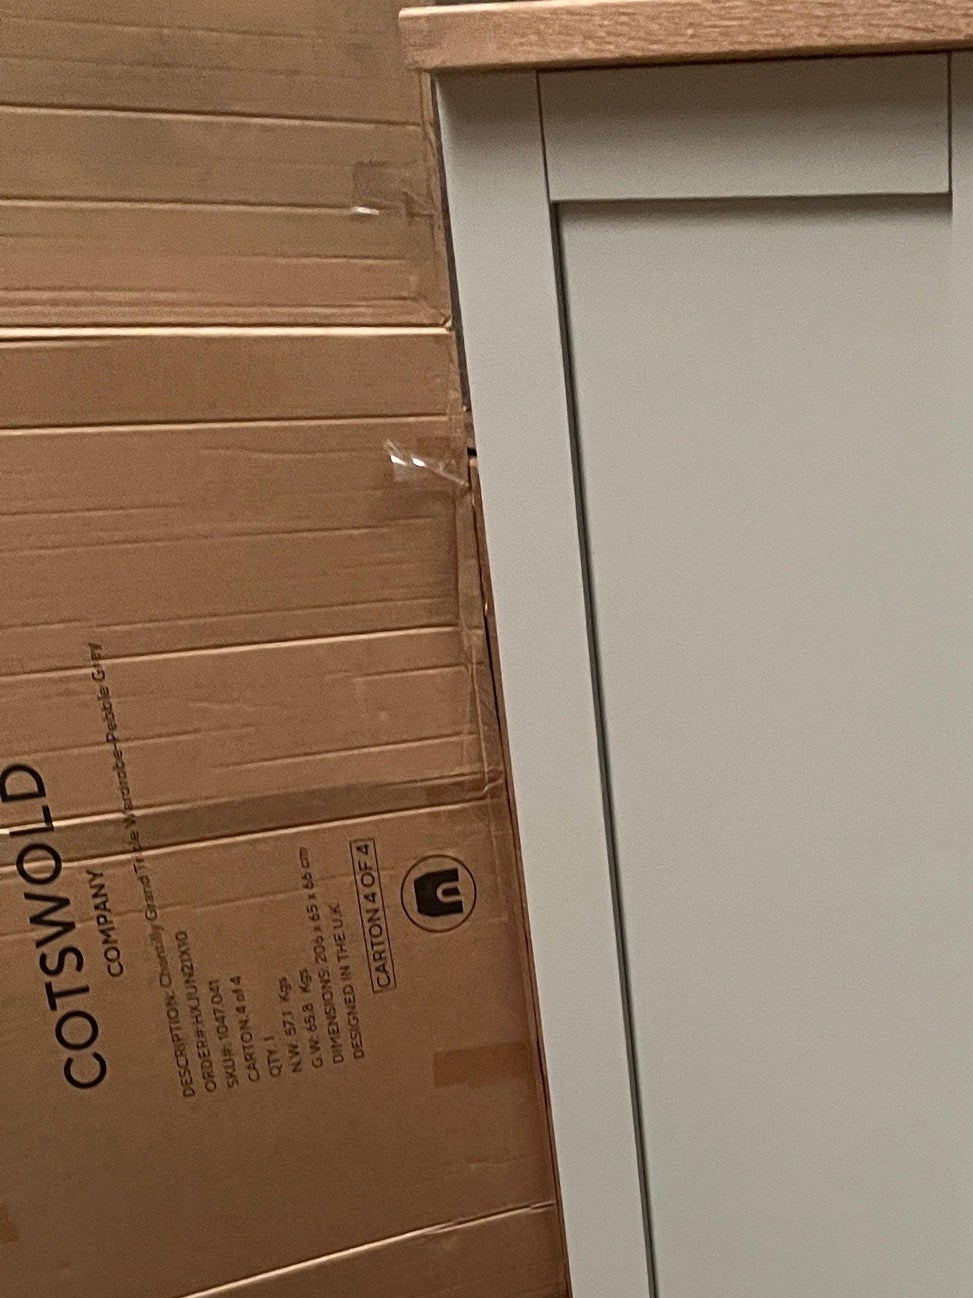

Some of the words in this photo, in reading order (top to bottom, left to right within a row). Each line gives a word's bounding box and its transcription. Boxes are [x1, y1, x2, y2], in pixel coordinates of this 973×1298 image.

[130, 830, 145, 873] Trple
[300, 846, 310, 868] cm
[356, 844, 368, 856] 4
[302, 871, 314, 890] 66
[358, 860, 375, 888] OF
[138, 875, 158, 922] Grand
[363, 892, 377, 903] 4
[85, 870, 124, 977] COMPANY
[306, 902, 320, 922] 65
[0, 764, 107, 1089] COTSWOLD
[313, 935, 327, 964] 206
[334, 931, 348, 962] THE
[366, 908, 391, 988] CARTON
[230, 976, 241, 984] 4
[298, 968, 312, 993] Kgs
[339, 965, 351, 981] IN
[232, 989, 245, 1002] of
[278, 976, 292, 1002] Kgs
[209, 980, 228, 1040] 1047.041
[235, 1005, 246, 1014] 4
[318, 967, 344, 1064] DIMENSIONS:
[342, 984, 365, 1059] DESIGNED
[165, 990, 195, 1098] DESCRIPTION:
[238, 1014, 260, 1082] CARTON:
